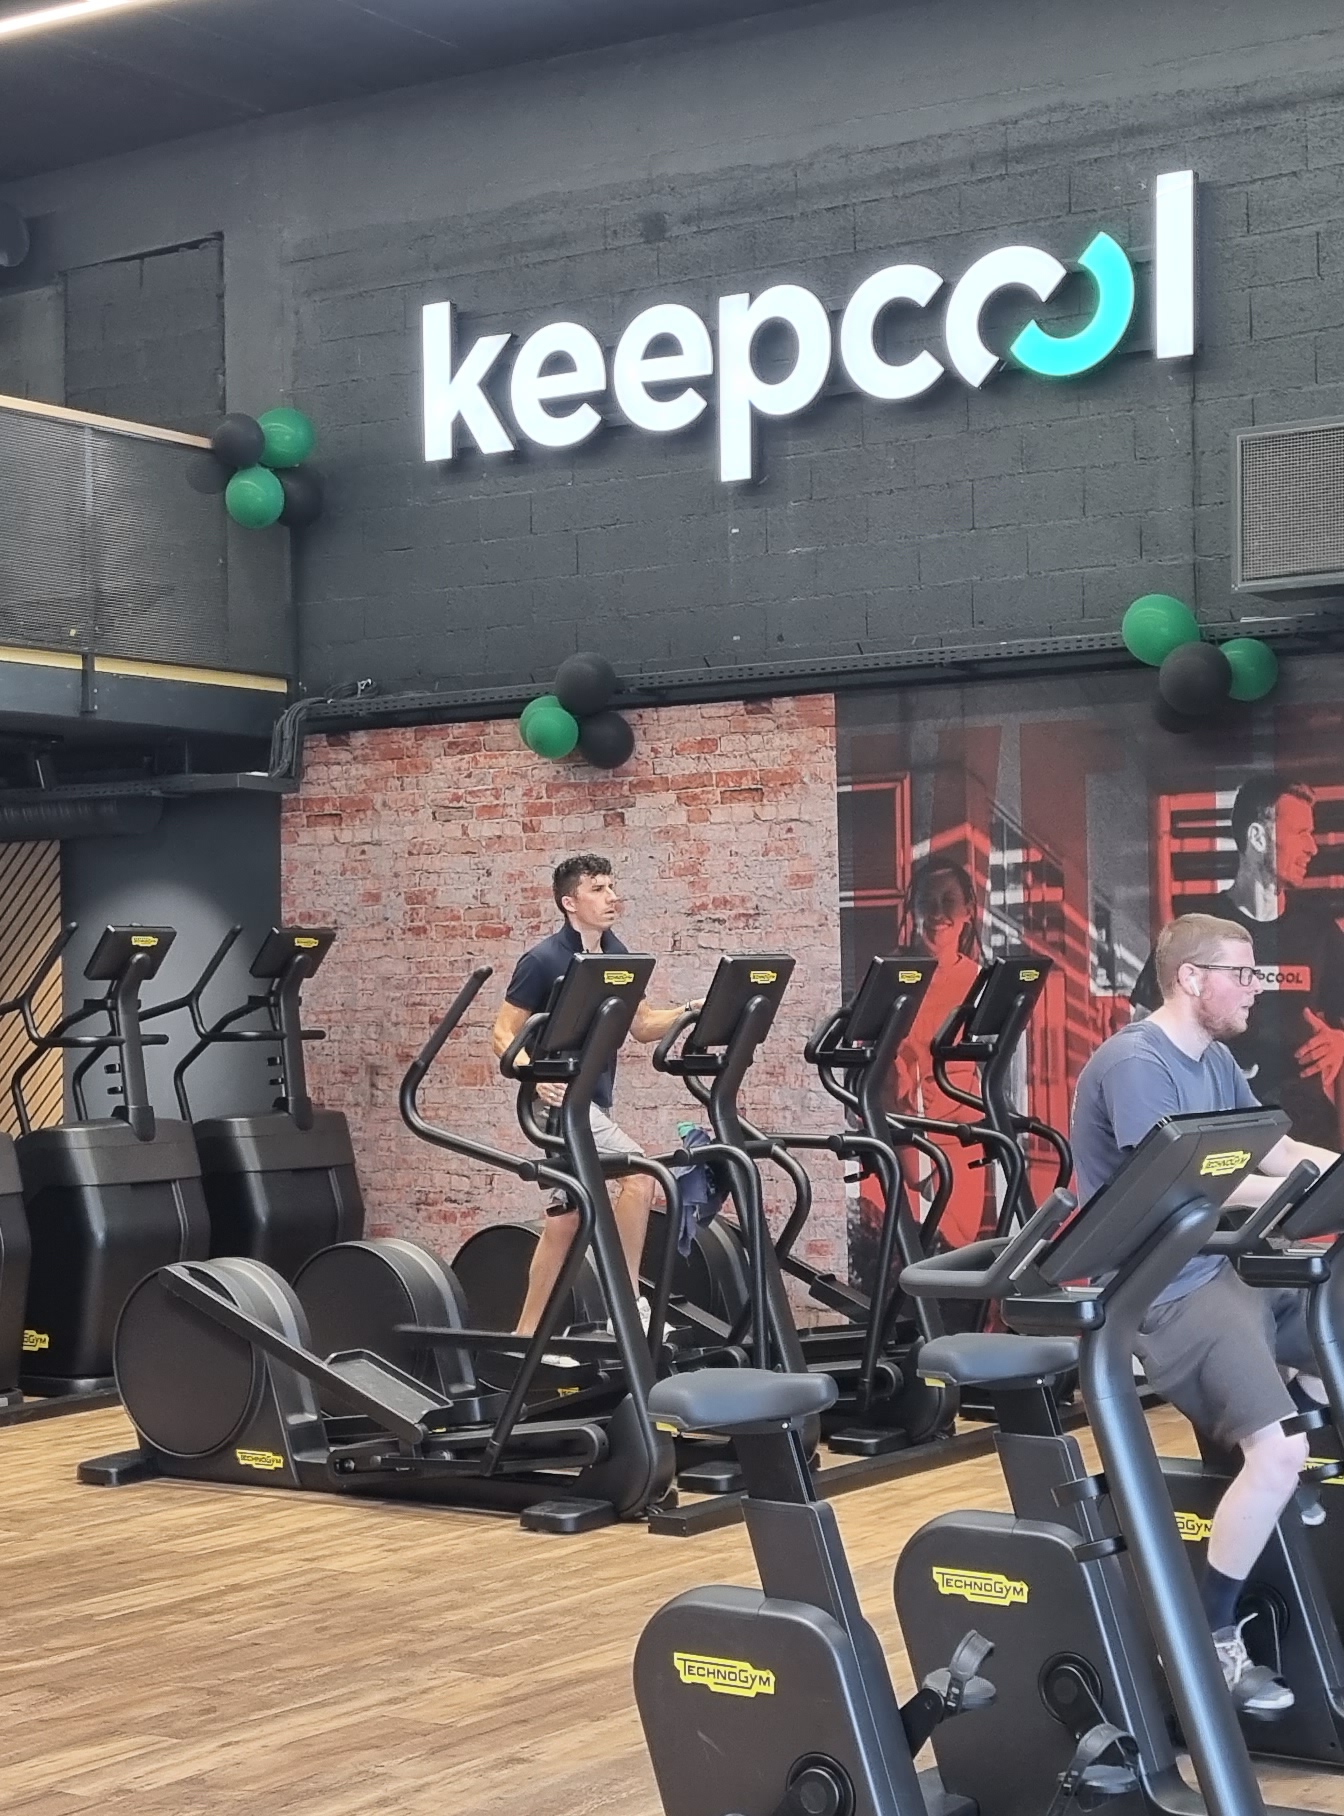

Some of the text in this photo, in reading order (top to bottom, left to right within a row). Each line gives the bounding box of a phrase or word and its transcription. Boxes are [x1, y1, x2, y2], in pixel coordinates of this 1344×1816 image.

[421, 169, 1198, 483] keepcool
[936, 1571, 1025, 1600] TECHNOGYM
[677, 1657, 772, 1691] TECHNOGYM
